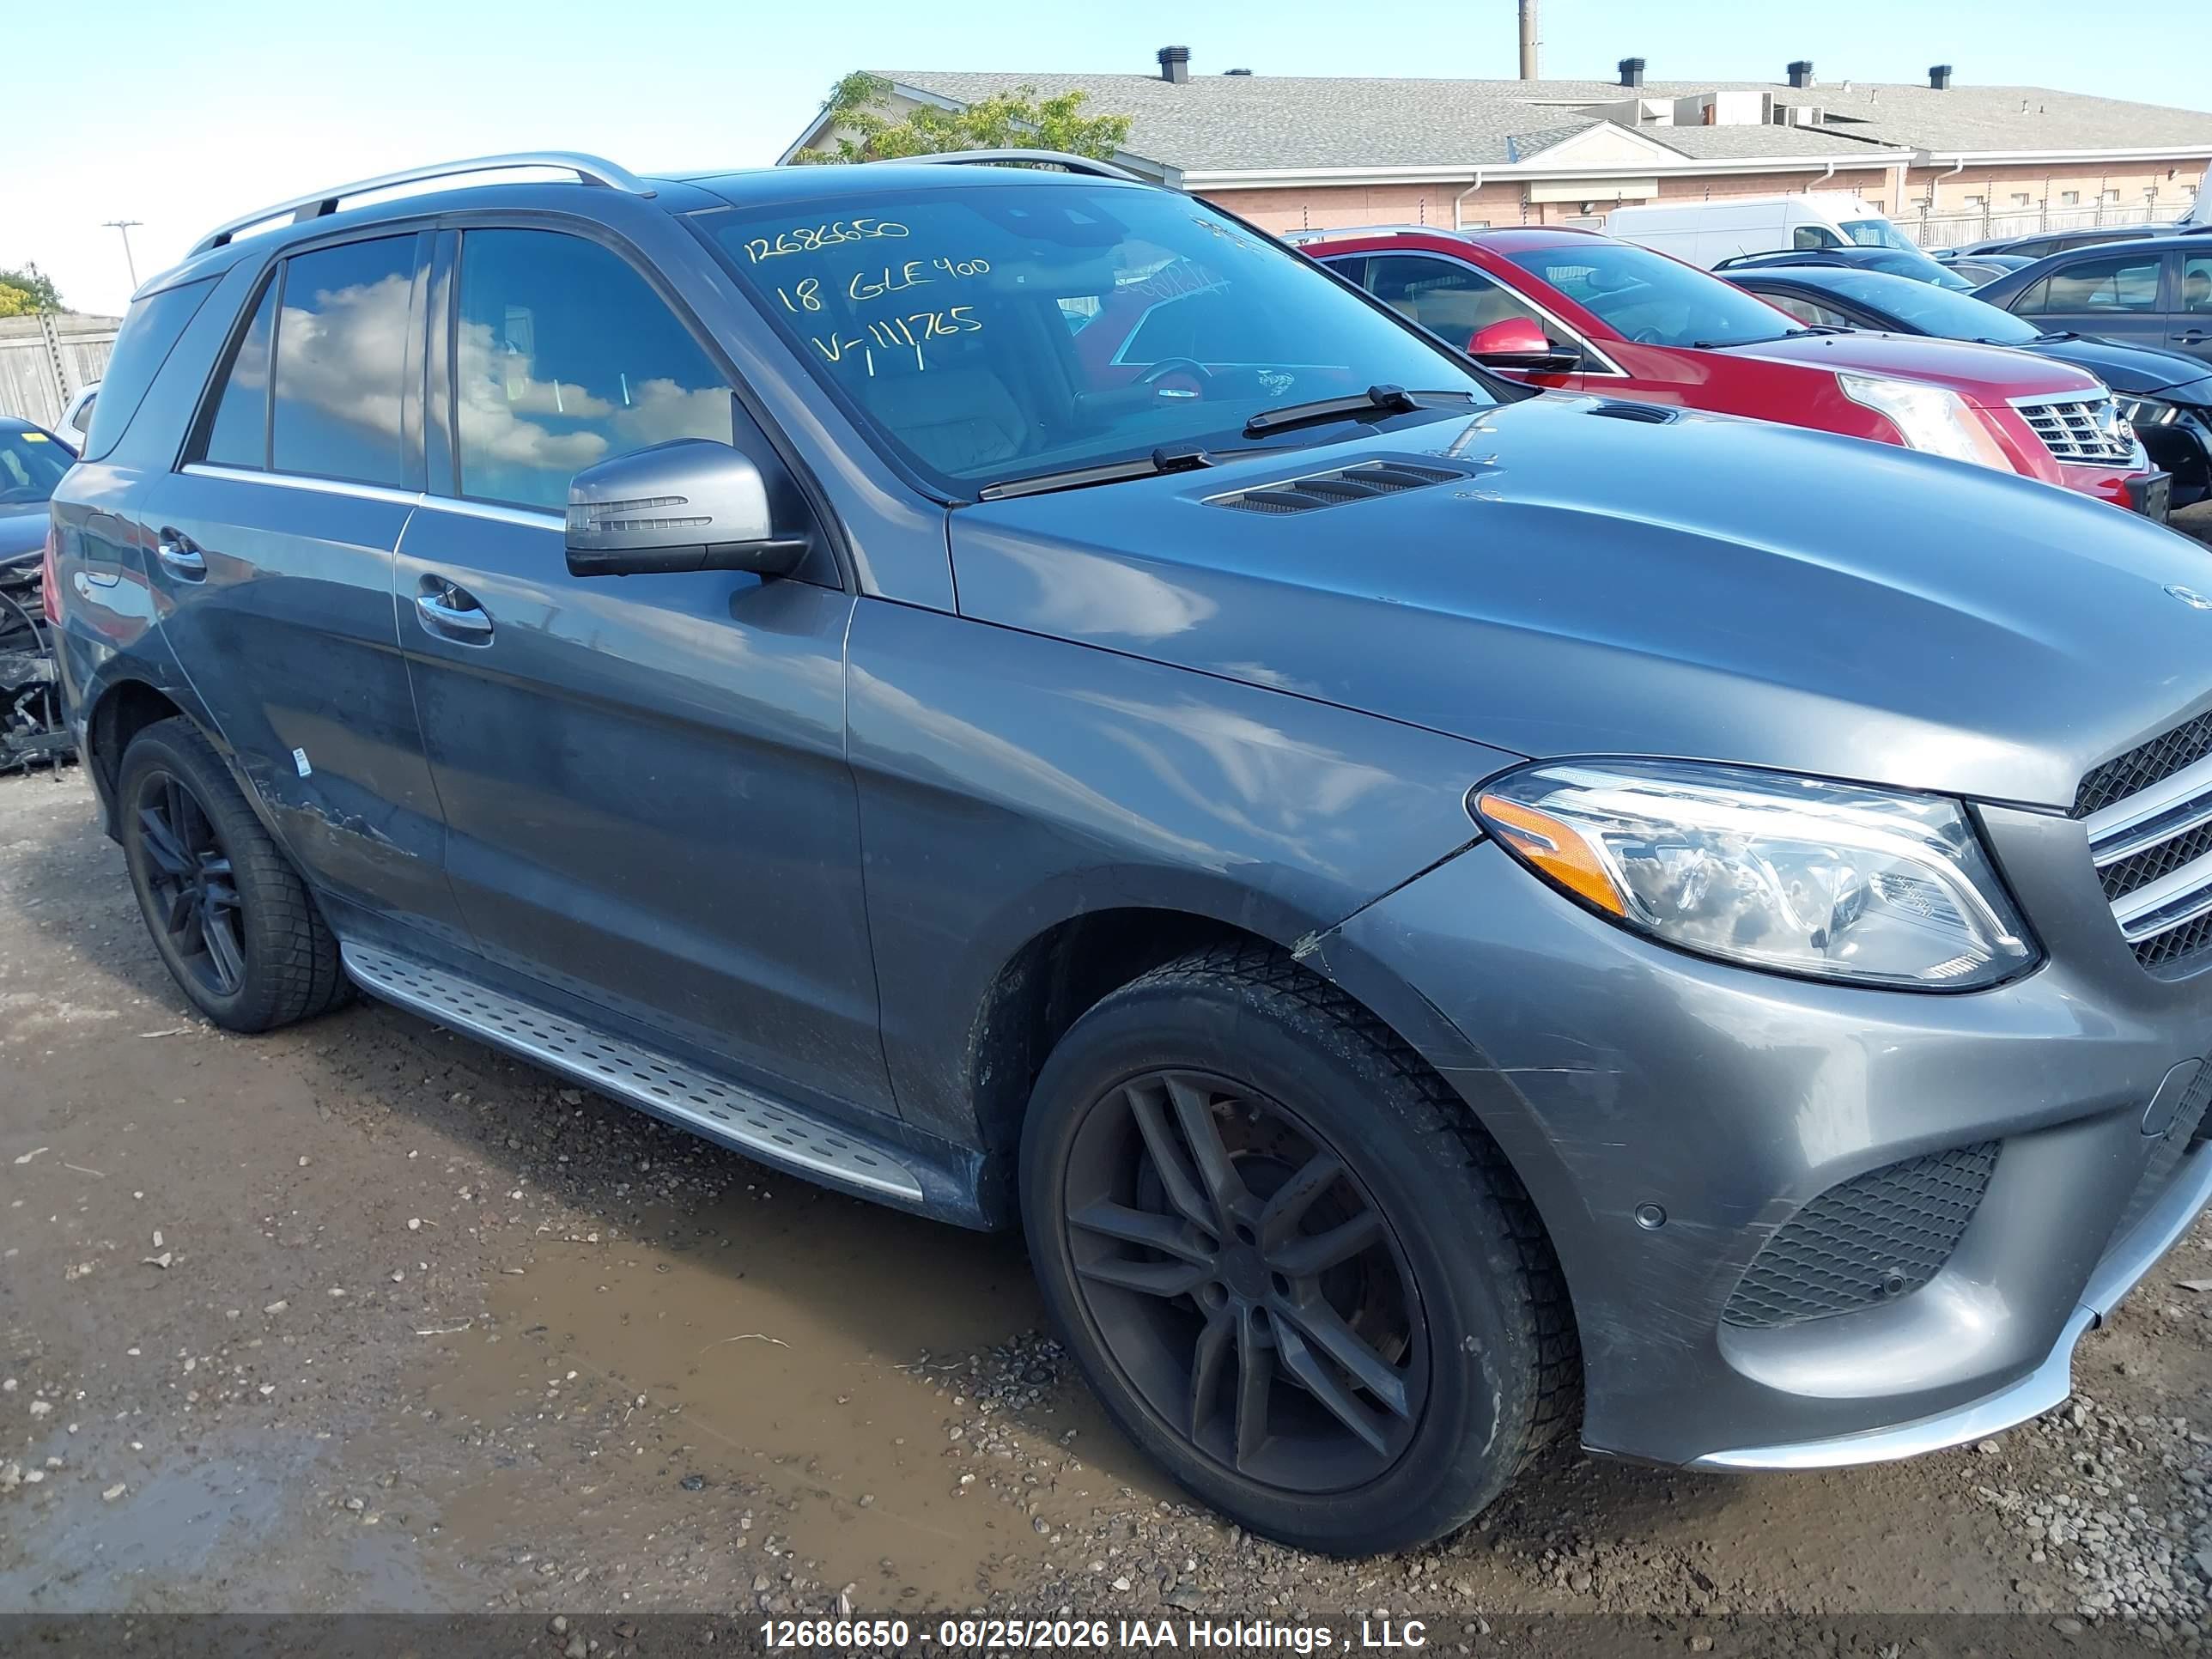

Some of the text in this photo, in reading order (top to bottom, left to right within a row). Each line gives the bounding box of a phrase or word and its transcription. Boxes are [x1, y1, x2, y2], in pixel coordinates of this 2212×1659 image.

[744, 218, 909, 264] 12686650
[777, 258, 990, 313] 18 GLE 400
